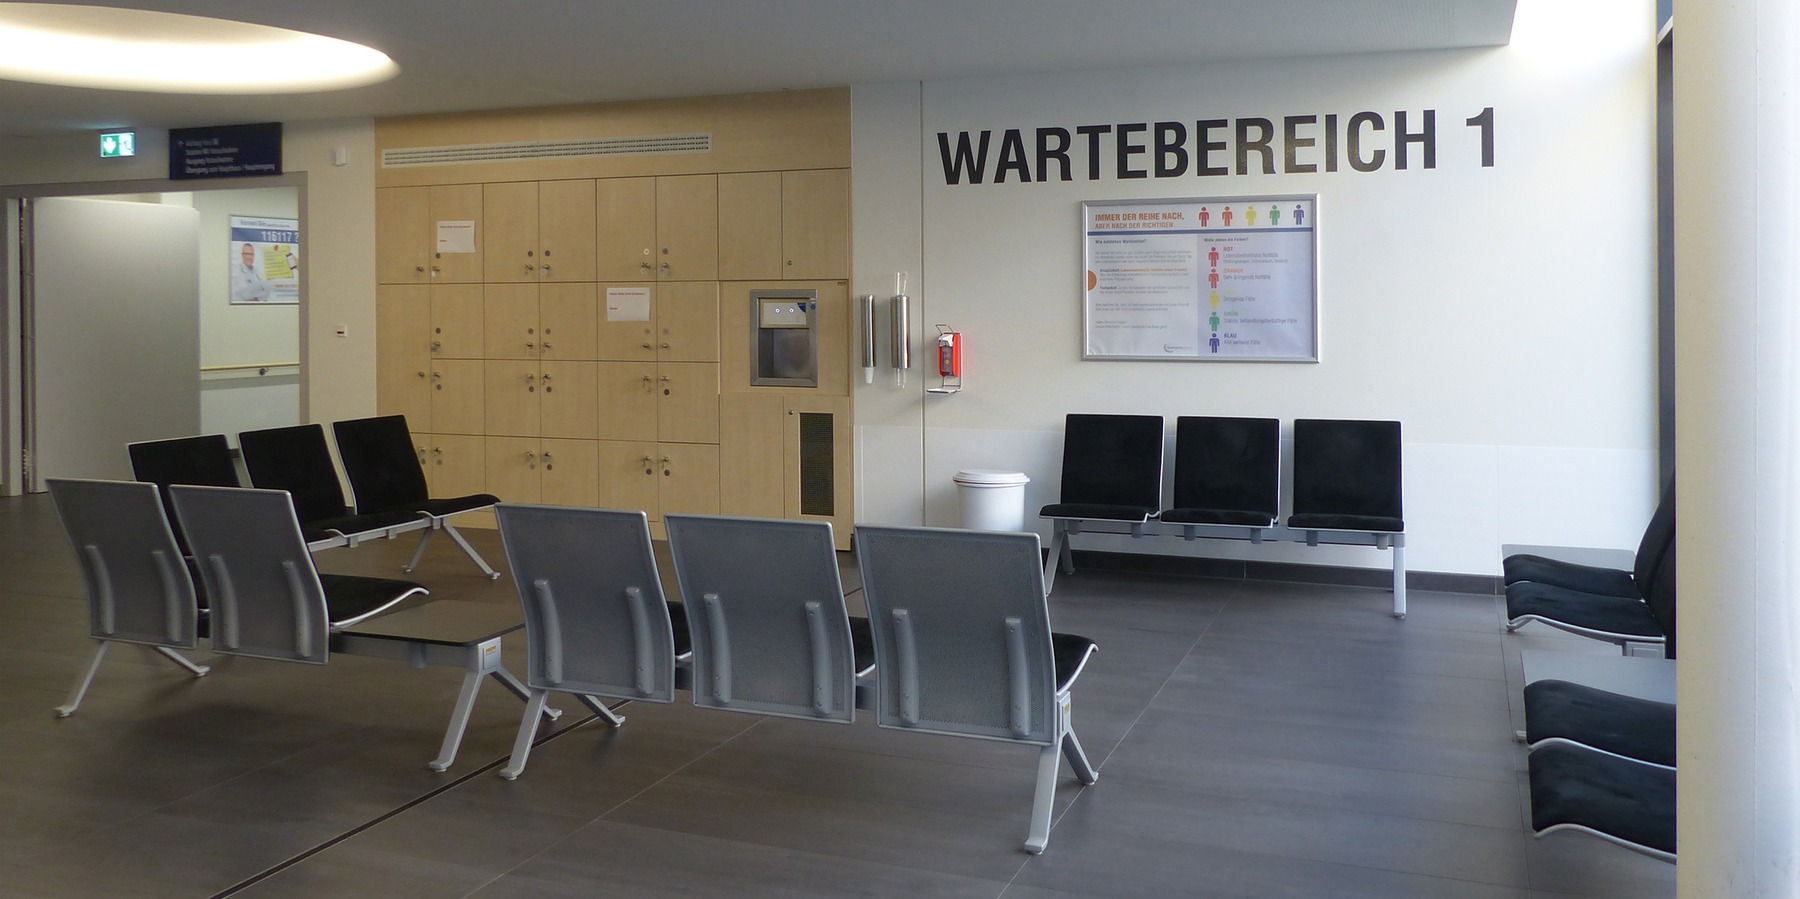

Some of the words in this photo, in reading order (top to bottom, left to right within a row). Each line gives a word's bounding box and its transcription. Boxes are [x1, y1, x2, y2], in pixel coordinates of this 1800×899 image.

[936, 109, 1436, 185] WARTEBEREICH
[1465, 106, 1495, 168] 1
[1095, 213, 1121, 221] IMMER
[1122, 213, 1137, 221] DER
[1138, 212, 1161, 221] REIHE
[1161, 211, 1185, 220] NACH,
[1095, 222, 1110, 230] ABER
[260, 230, 293, 243] 116117
